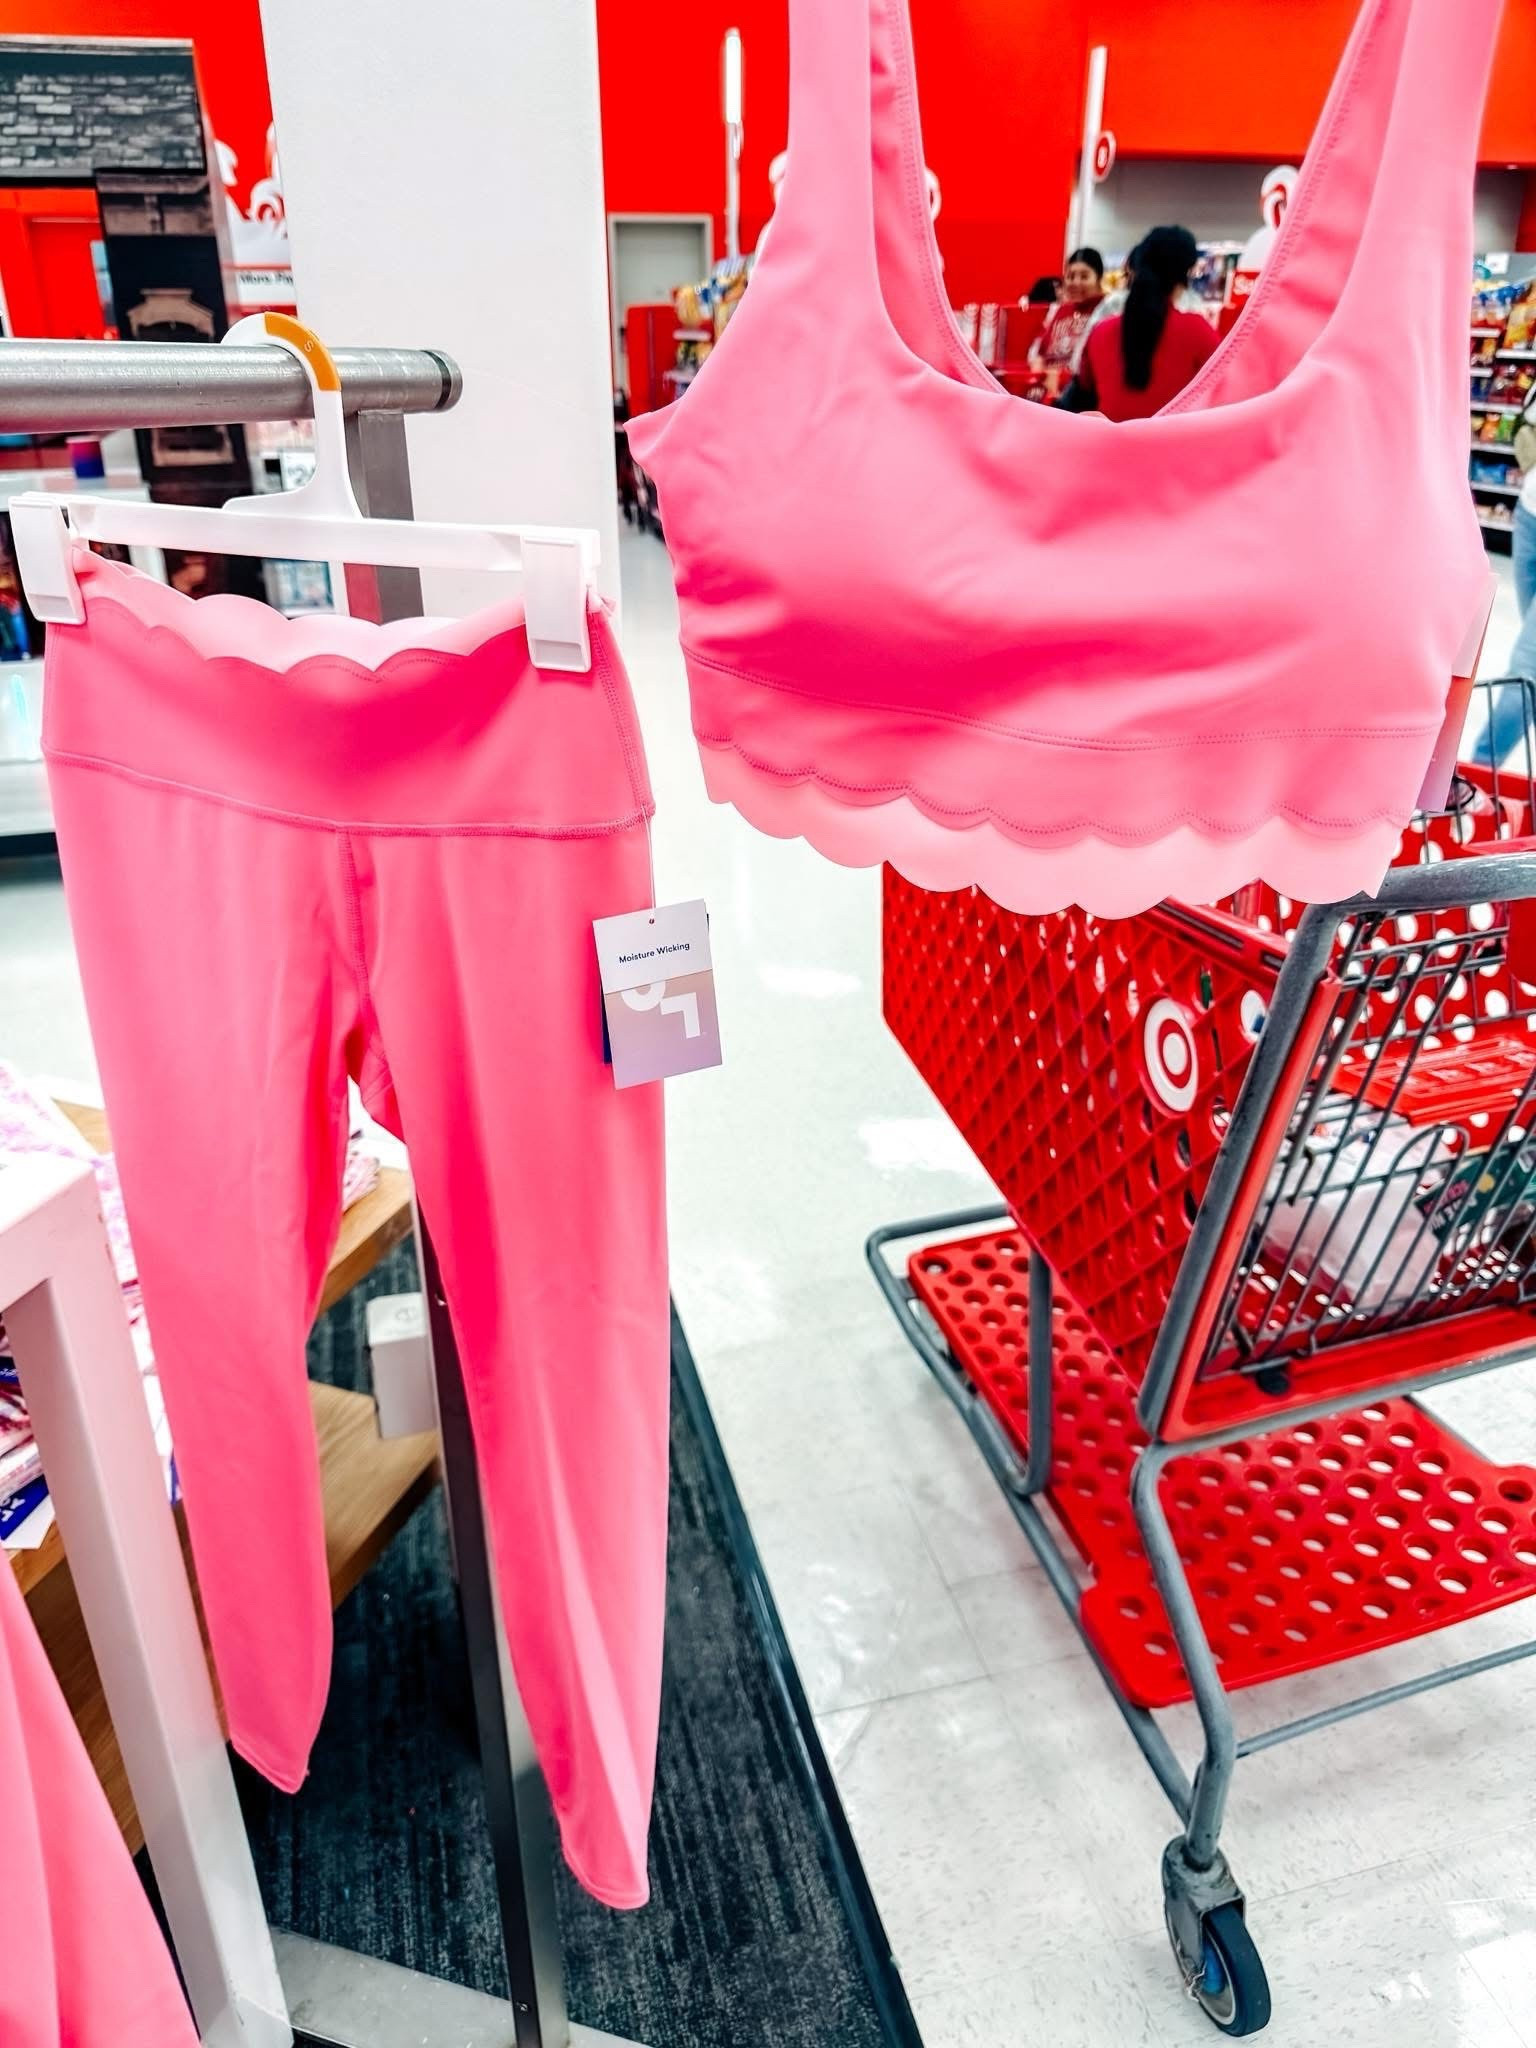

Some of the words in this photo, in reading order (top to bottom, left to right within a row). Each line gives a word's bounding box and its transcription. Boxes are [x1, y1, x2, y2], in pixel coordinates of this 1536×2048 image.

[304, 340, 314, 352] S
[619, 951, 655, 963] Moisture
[656, 943, 690, 955] Wicking
